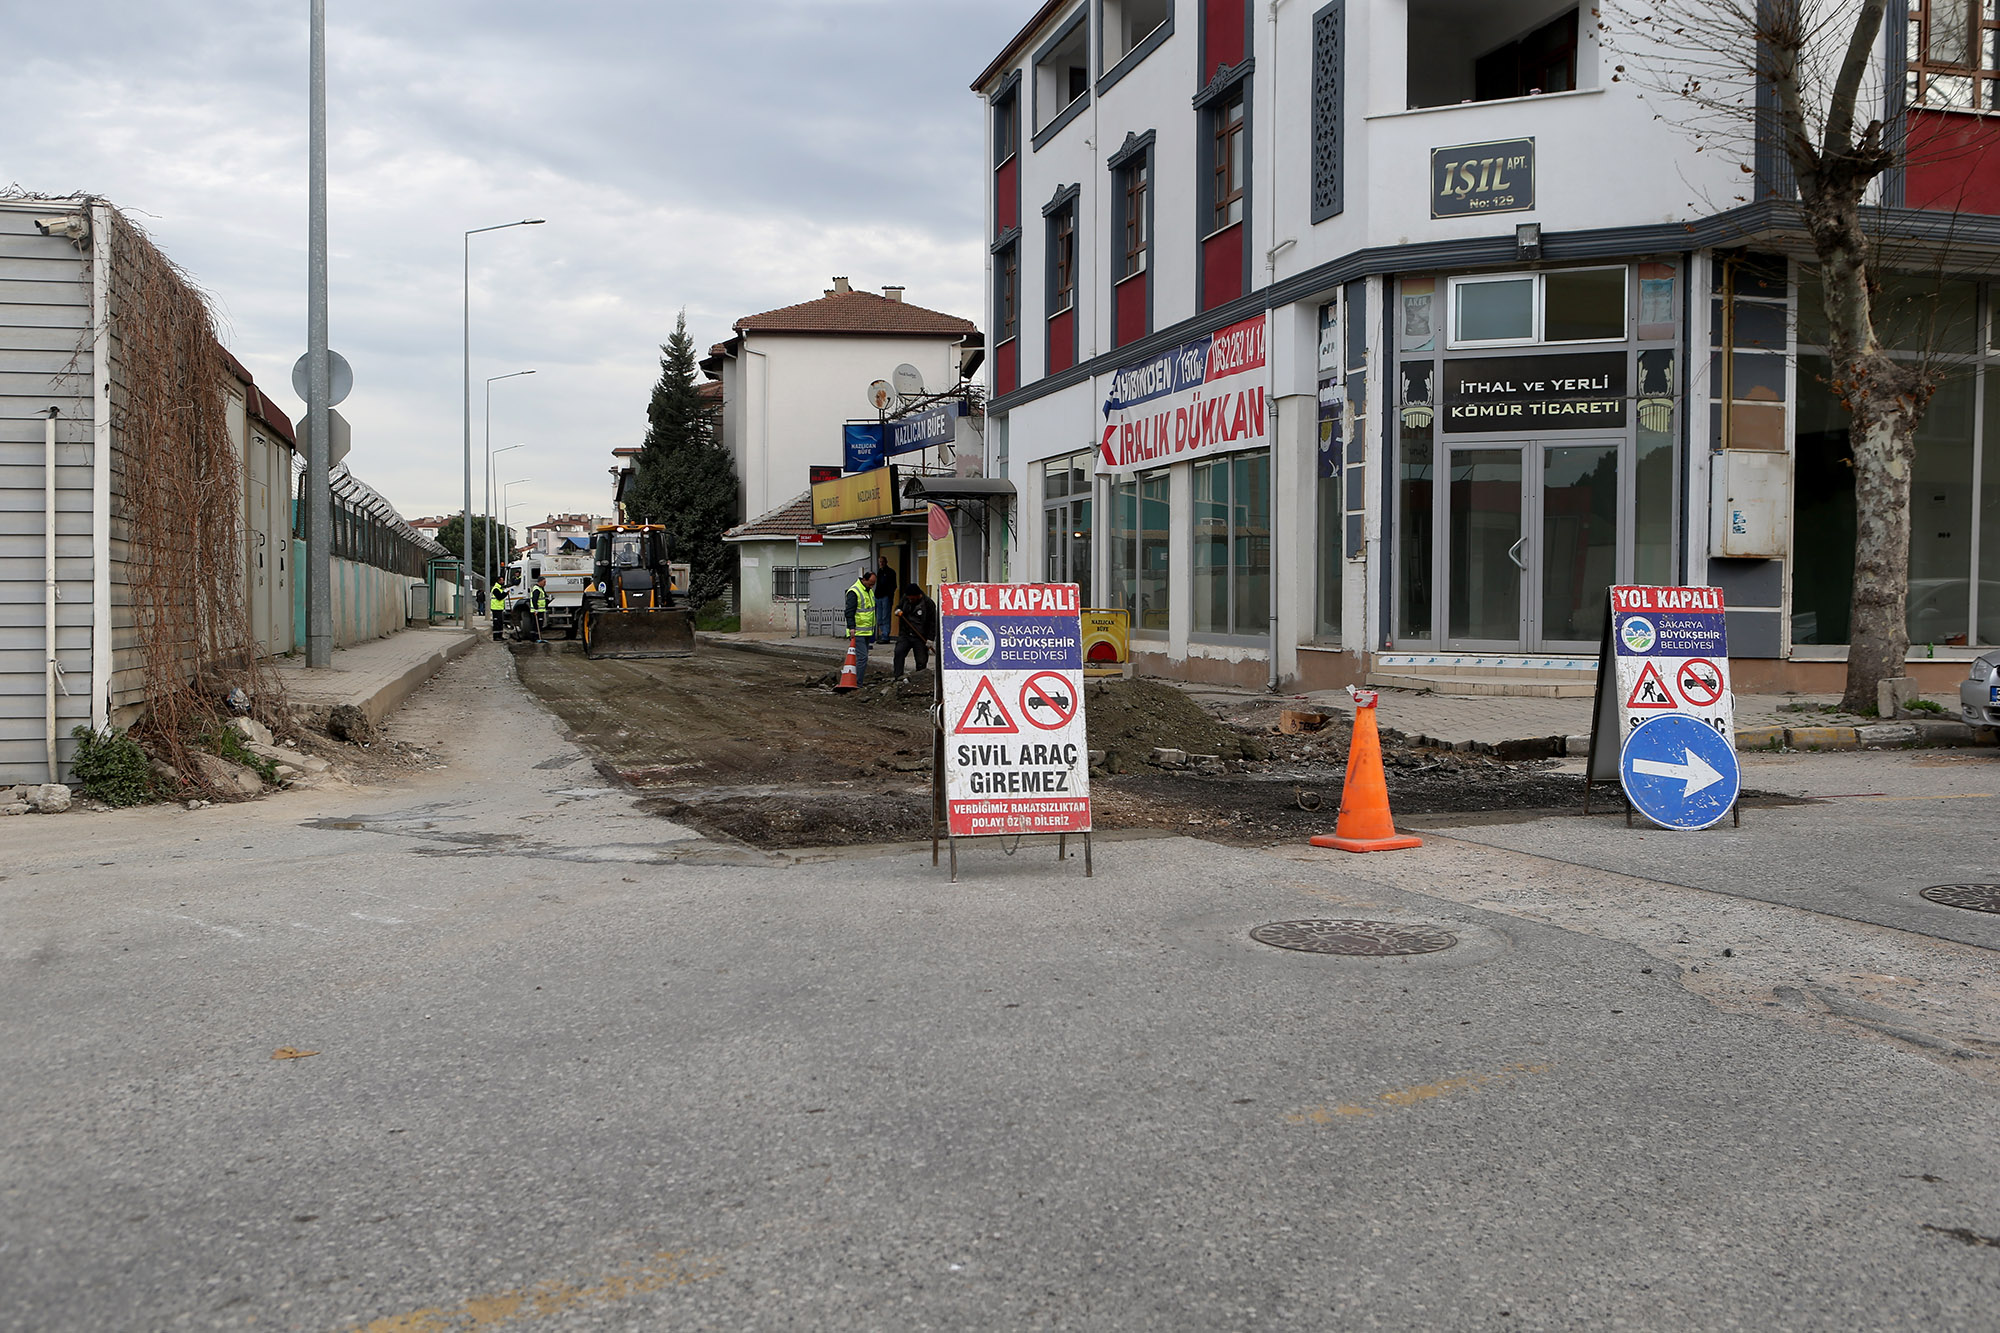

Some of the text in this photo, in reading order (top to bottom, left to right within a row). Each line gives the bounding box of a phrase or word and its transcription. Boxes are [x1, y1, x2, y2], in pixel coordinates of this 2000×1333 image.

[1440, 155, 1528, 200] IŞIL APT.
[1469, 195, 1515, 209] No: 129
[1459, 374, 1609, 394] İTHAL VE YERLİ
[1451, 400, 1620, 418] KÖMÜR TİCARETİ
[894, 412, 946, 447] NAZLICAN BÜFE
[1100, 385, 1265, 466] KİRALIK DÜKKAN
[948, 588, 1075, 611] YOL KAPALI
[1617, 589, 1719, 609] YOL KAPALI
[999, 625, 1055, 635] SAKARYA
[1659, 620, 1703, 629] SAKARYA
[1000, 636, 1075, 649] BÜYÜKŞEHİR
[1660, 630, 1720, 640] BÜYÜKŞEHİR
[1661, 640, 1714, 650] BELEDİYESİ
[1001, 649, 1067, 660] BELEDİYESİ
[957, 742, 1078, 771] SİVİL ARAÇ
[970, 771, 1069, 794] GİREMEZ
[1011, 802, 1086, 814] RAHATSIZLIKTAN
[971, 817, 1005, 828] DOLAYI
[1034, 814, 1070, 826] DİLERİZ
